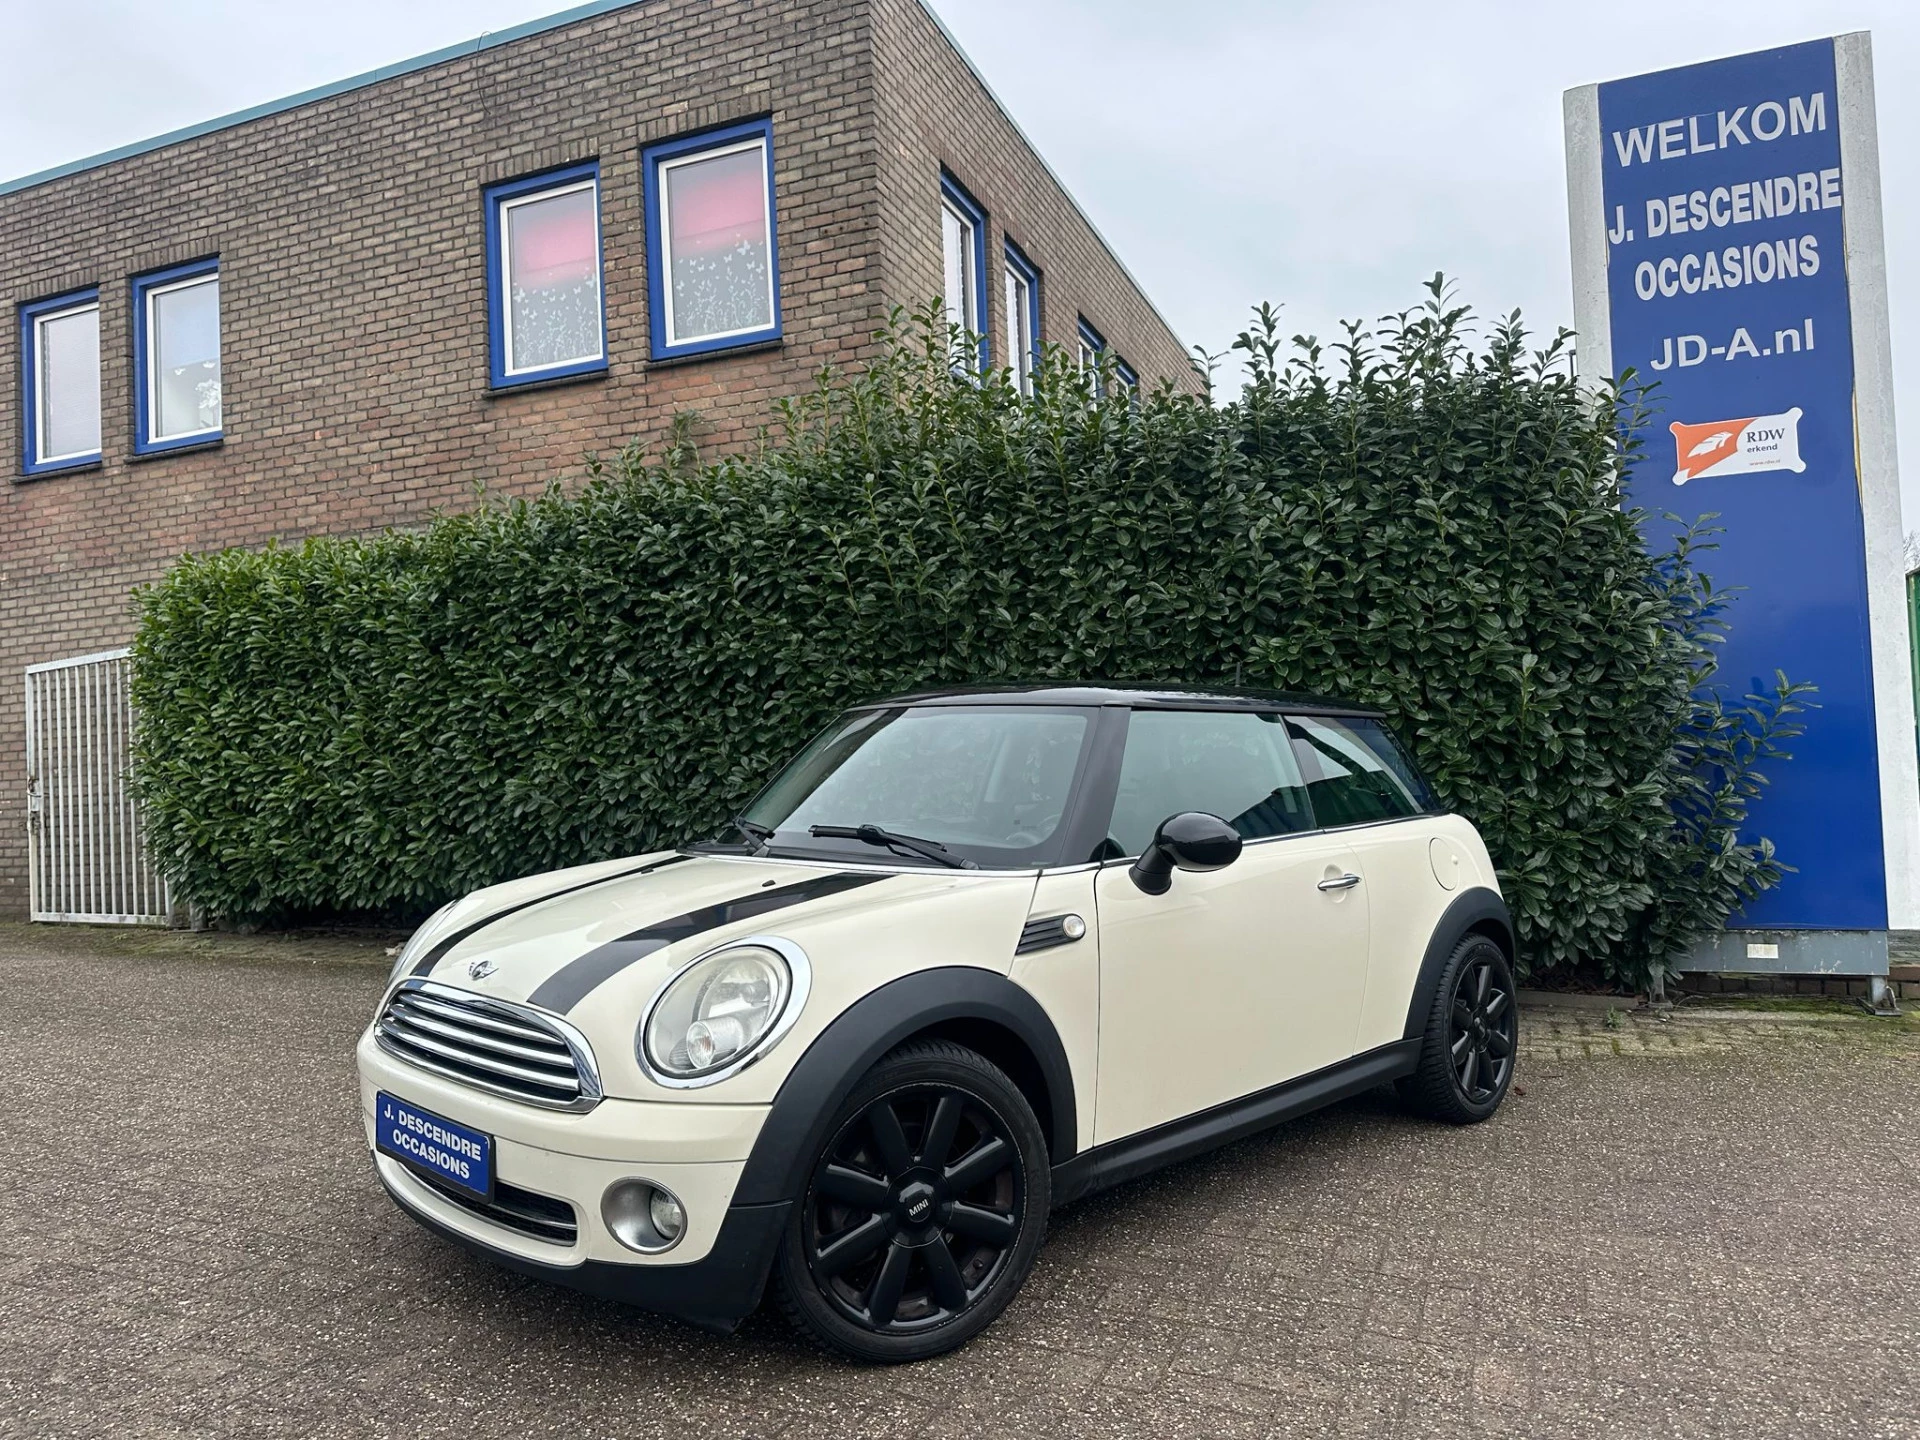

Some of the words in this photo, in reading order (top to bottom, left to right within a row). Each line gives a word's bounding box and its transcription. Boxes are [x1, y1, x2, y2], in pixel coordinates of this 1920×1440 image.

[1612, 92, 1826, 167] WELKOM
[1608, 205, 1634, 245] J.
[1646, 167, 1842, 238] DESCENDRE
[1634, 234, 1820, 301] OCCASIONS
[1650, 318, 1814, 371] JD-A.nl
[1746, 428, 1785, 443] RDW
[1747, 443, 1778, 453] erkend
[384, 1104, 394, 1120] J.
[398, 1110, 481, 1161] DESCENDRE
[393, 1129, 470, 1179] OCCASIONS
[908, 1199, 929, 1217] MINI
